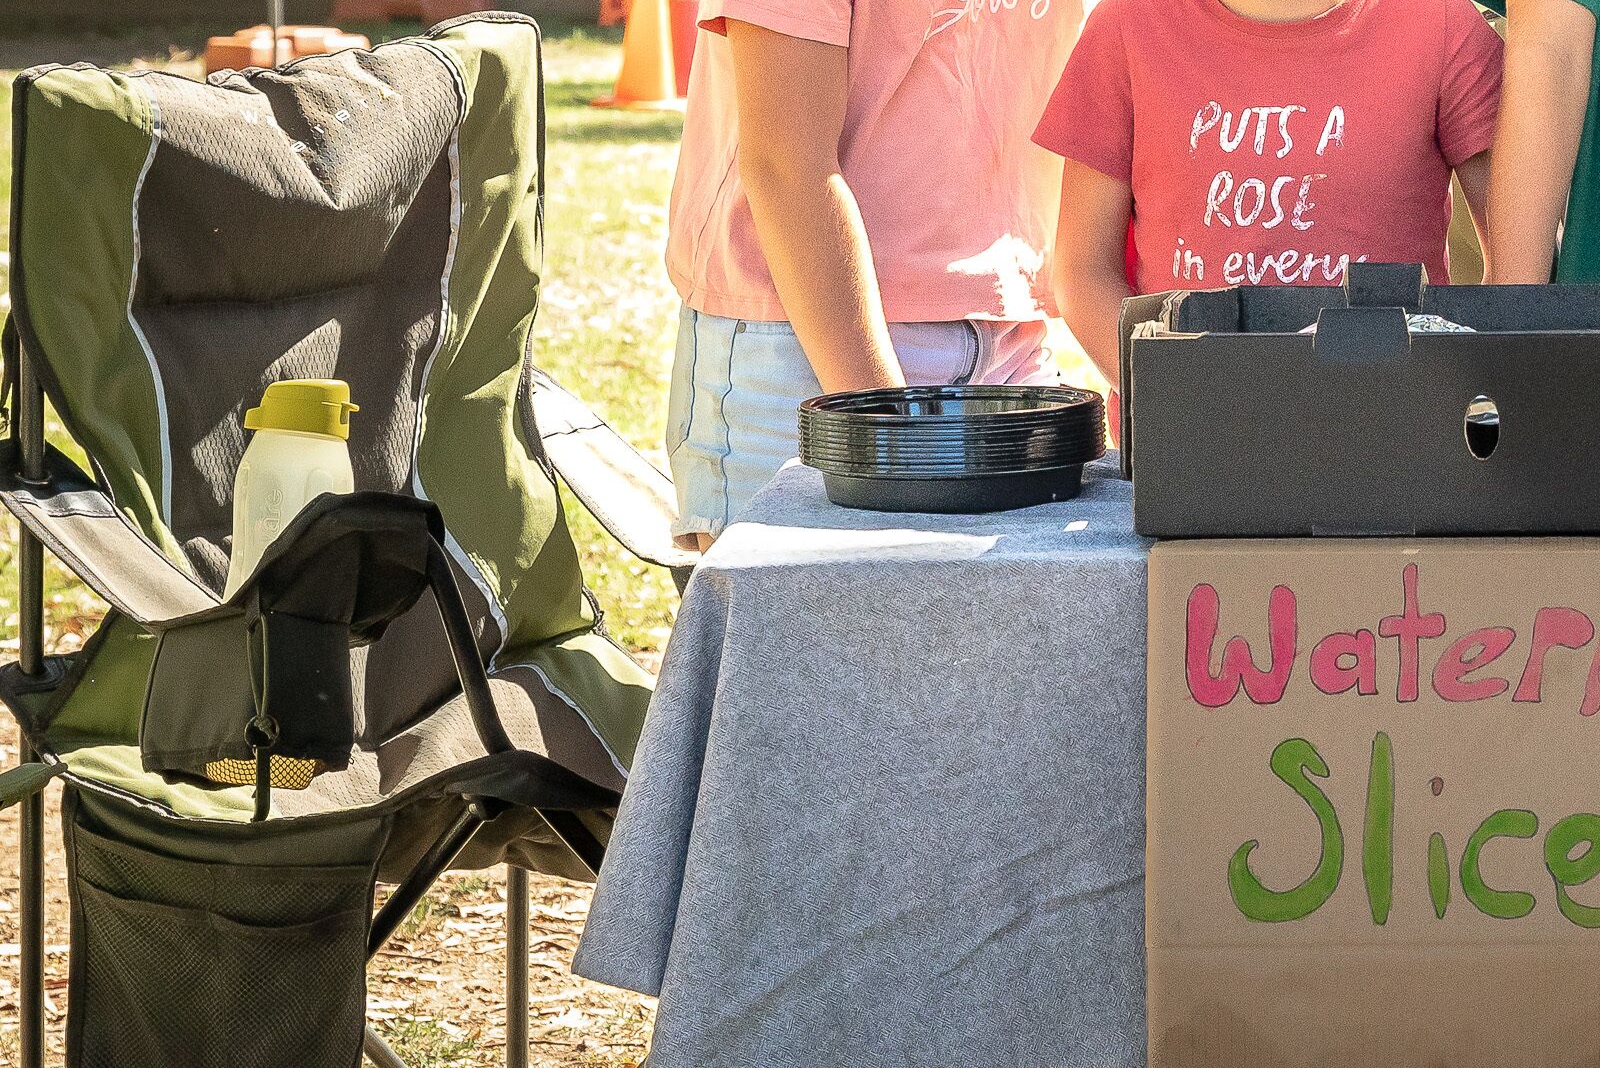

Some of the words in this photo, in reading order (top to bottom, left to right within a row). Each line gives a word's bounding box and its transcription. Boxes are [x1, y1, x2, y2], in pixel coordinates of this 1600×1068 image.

[1189, 100, 1307, 159] PUTS
[1315, 105, 1345, 156] A
[1203, 170, 1328, 231] ROSE
[1172, 237, 1204, 280] in
